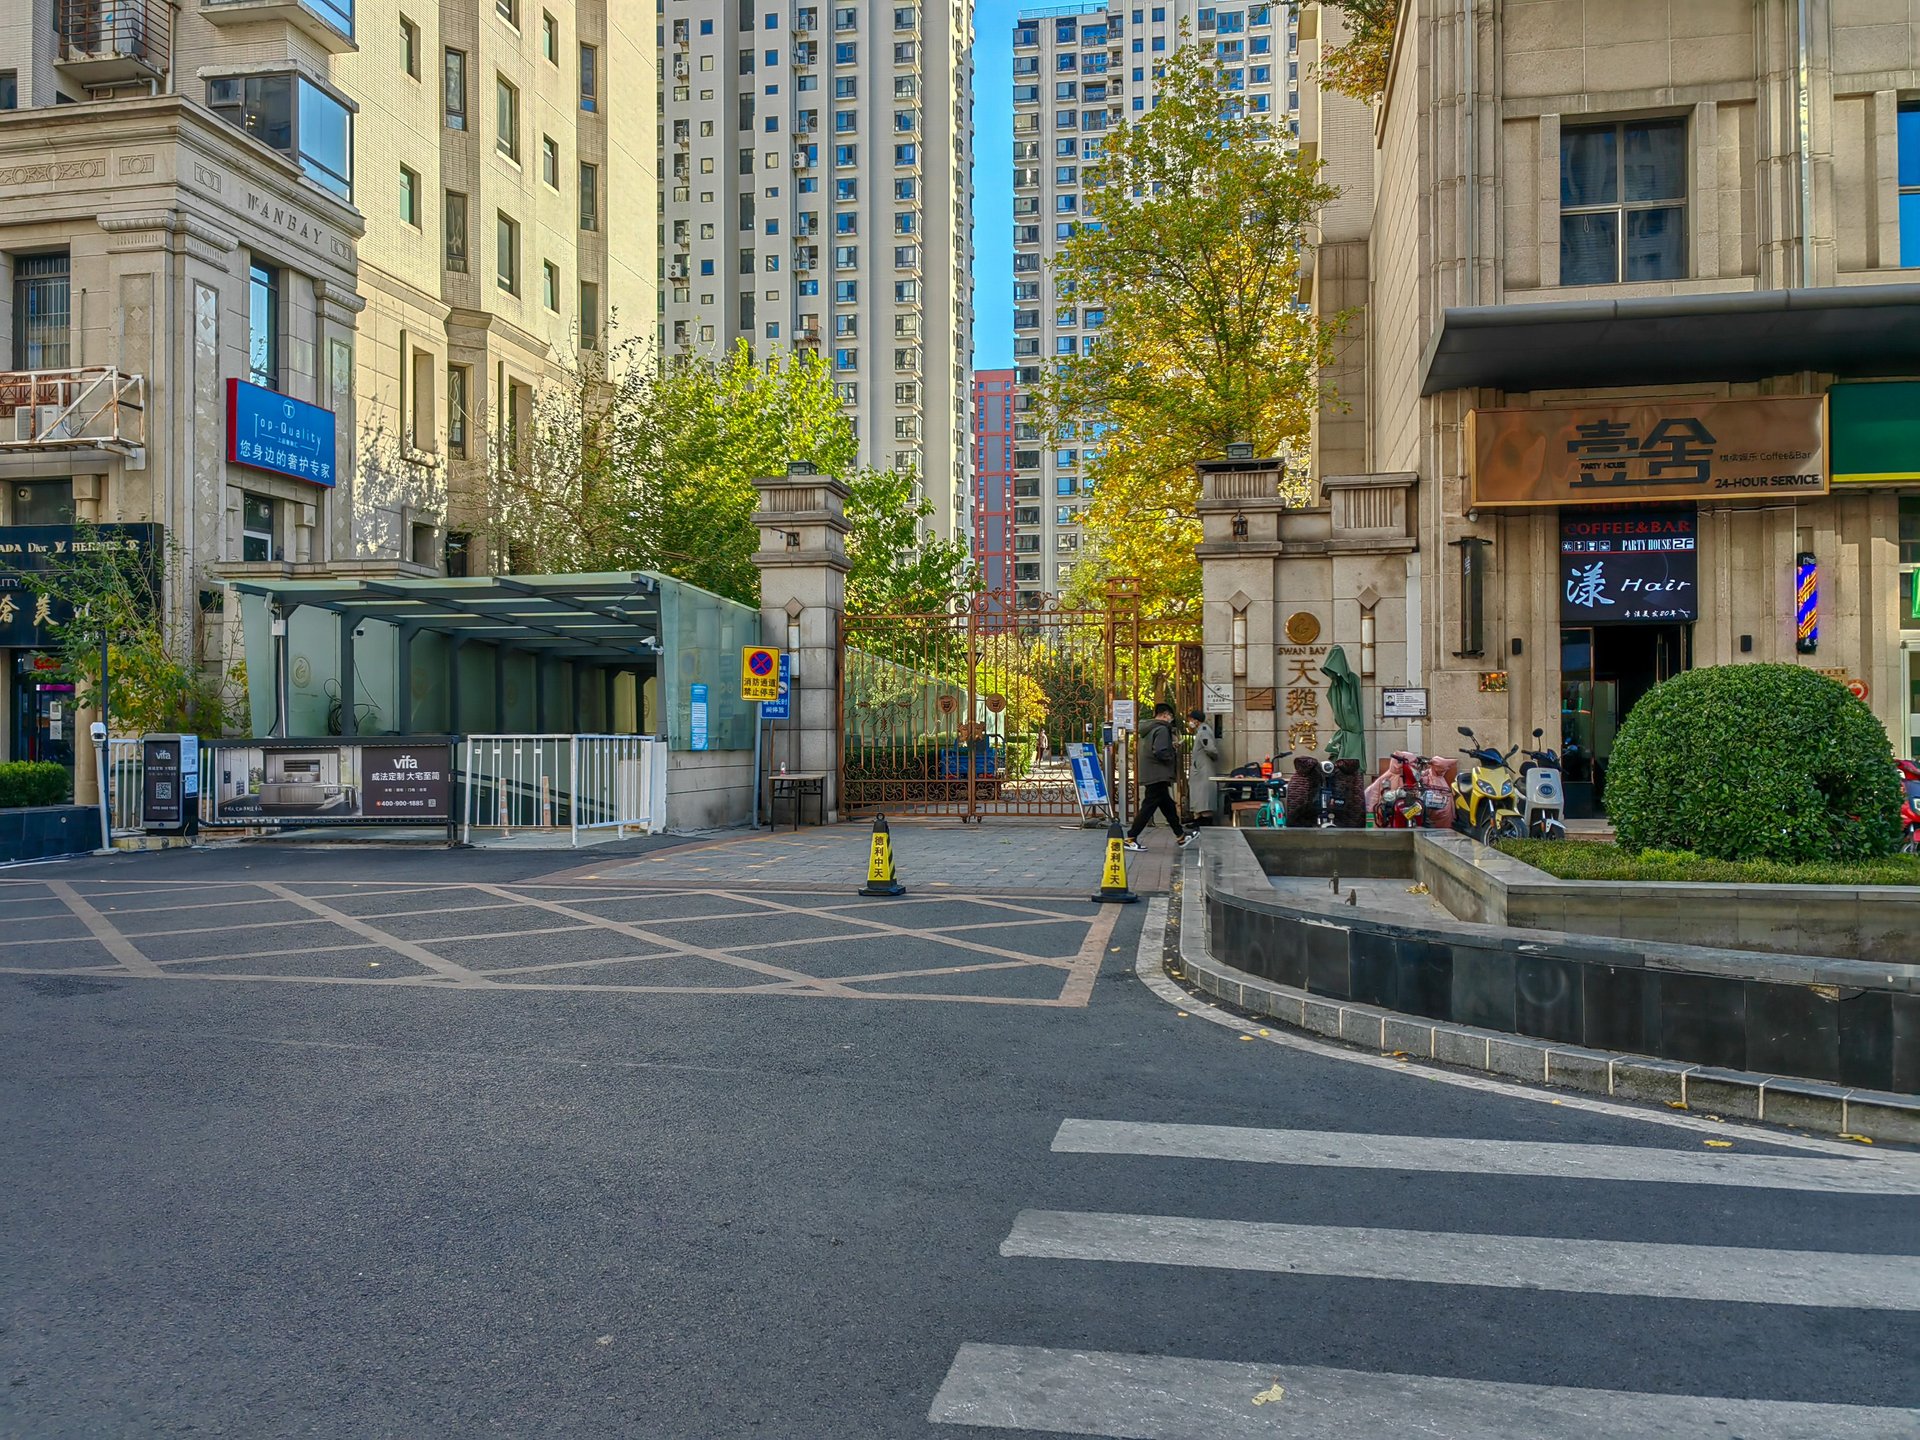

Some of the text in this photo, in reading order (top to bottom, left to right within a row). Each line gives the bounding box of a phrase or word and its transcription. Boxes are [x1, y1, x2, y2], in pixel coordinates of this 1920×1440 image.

[254, 413, 321, 456] Top-Quality
[240, 439, 330, 478] 您身边的奢护专家
[1760, 451, 1812, 461] Coffee&Bar
[1715, 474, 1820, 489] 24-HOUR SERVICE
[1564, 521, 1691, 536] COFFEE&BAR
[28, 542, 49, 553] Dior
[1622, 538, 1695, 551] PARTY HOUSE 2F
[0, 578, 20, 587] ITY
[1566, 561, 1615, 608] 漾
[1620, 578, 1691, 591] Hair
[1279, 646, 1327, 656] SWAN BAY
[744, 677, 777, 687] 消防通道
[744, 687, 776, 697] 禁止停车
[1286, 658, 1319, 752] 天鹅湾
[155, 749, 171, 760] vifa
[393, 755, 418, 769] vifa
[406, 771, 440, 781] 大宅至简
[873, 836, 885, 878] 德利中天
[1110, 841, 1121, 885] 德利中天
